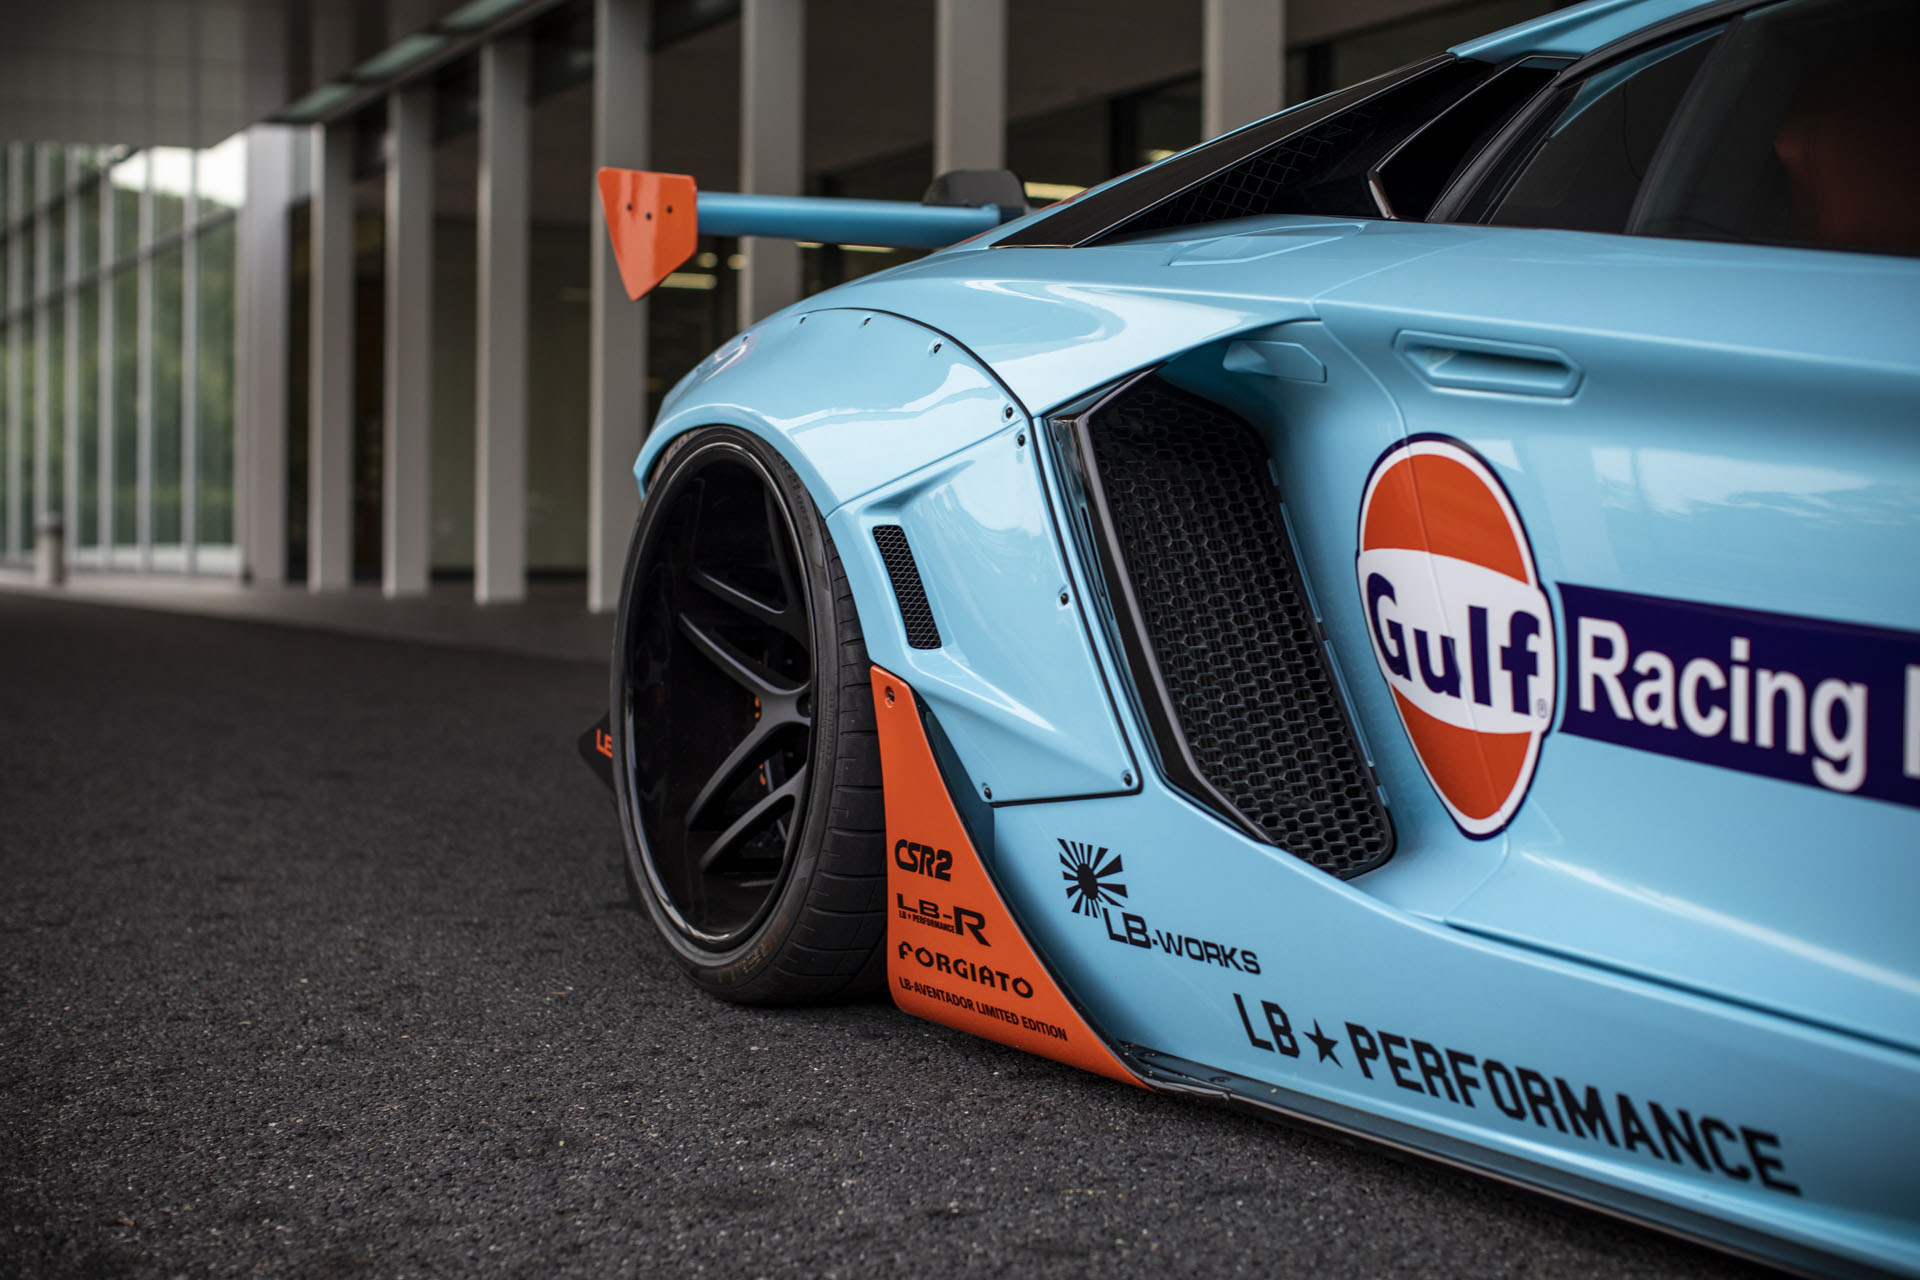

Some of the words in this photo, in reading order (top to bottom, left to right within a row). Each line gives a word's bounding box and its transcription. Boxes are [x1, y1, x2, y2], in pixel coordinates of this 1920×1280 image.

[1366, 572, 1541, 717] Gulf
[1577, 615, 1869, 793] Racing
[894, 838, 953, 882] CSR2
[896, 892, 992, 947] LB-R
[912, 914, 956, 934] PERFORMANCE
[898, 941, 1034, 999] FORGIATO
[899, 976, 976, 1013] LB-AVENTADOR
[976, 1001, 1020, 1026] LIMITED
[1021, 1015, 1069, 1042] EDITION
[1232, 992, 1301, 1059] LB
[1343, 1020, 1803, 1198] PERFORMANCE
